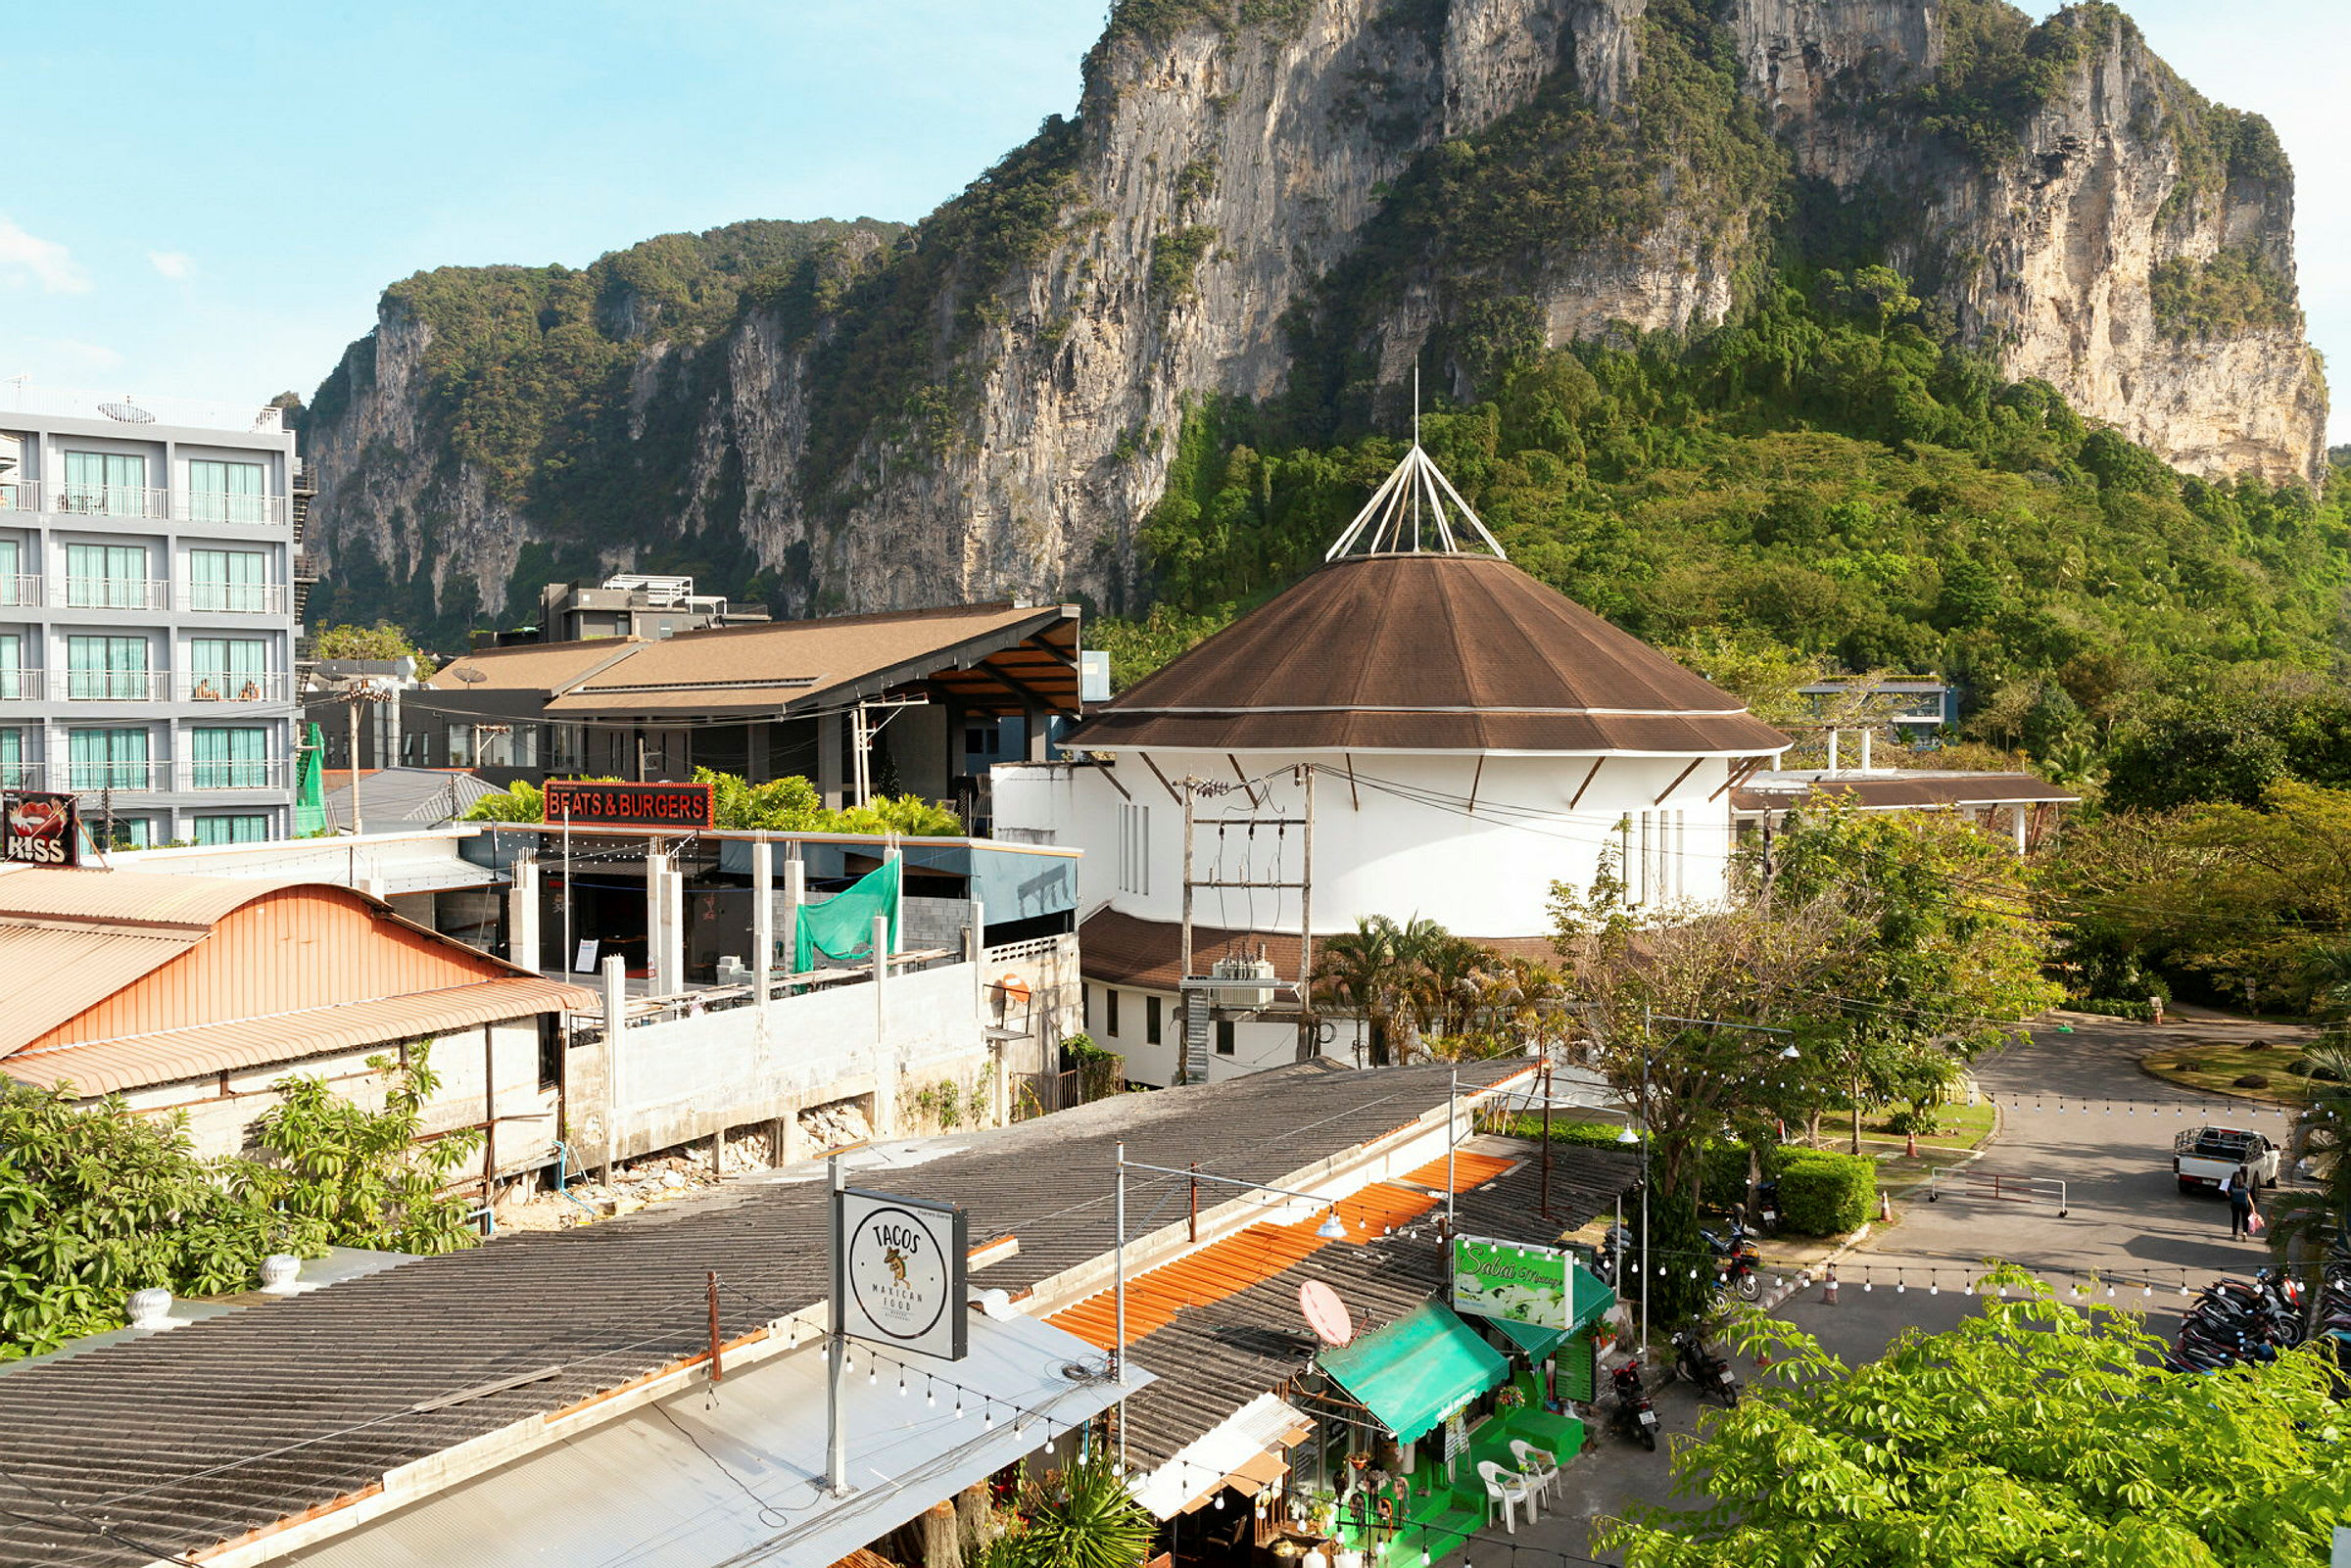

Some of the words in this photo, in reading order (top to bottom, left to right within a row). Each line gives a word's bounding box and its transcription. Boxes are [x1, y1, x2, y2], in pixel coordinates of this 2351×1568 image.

[550, 792, 601, 816] BEATS
[605, 793, 617, 816] &
[619, 794, 704, 819] BURGERS
[873, 1224, 921, 1254] TACOS
[1458, 1246, 1516, 1279] Sabai
[884, 1298, 911, 1311] FOOD
